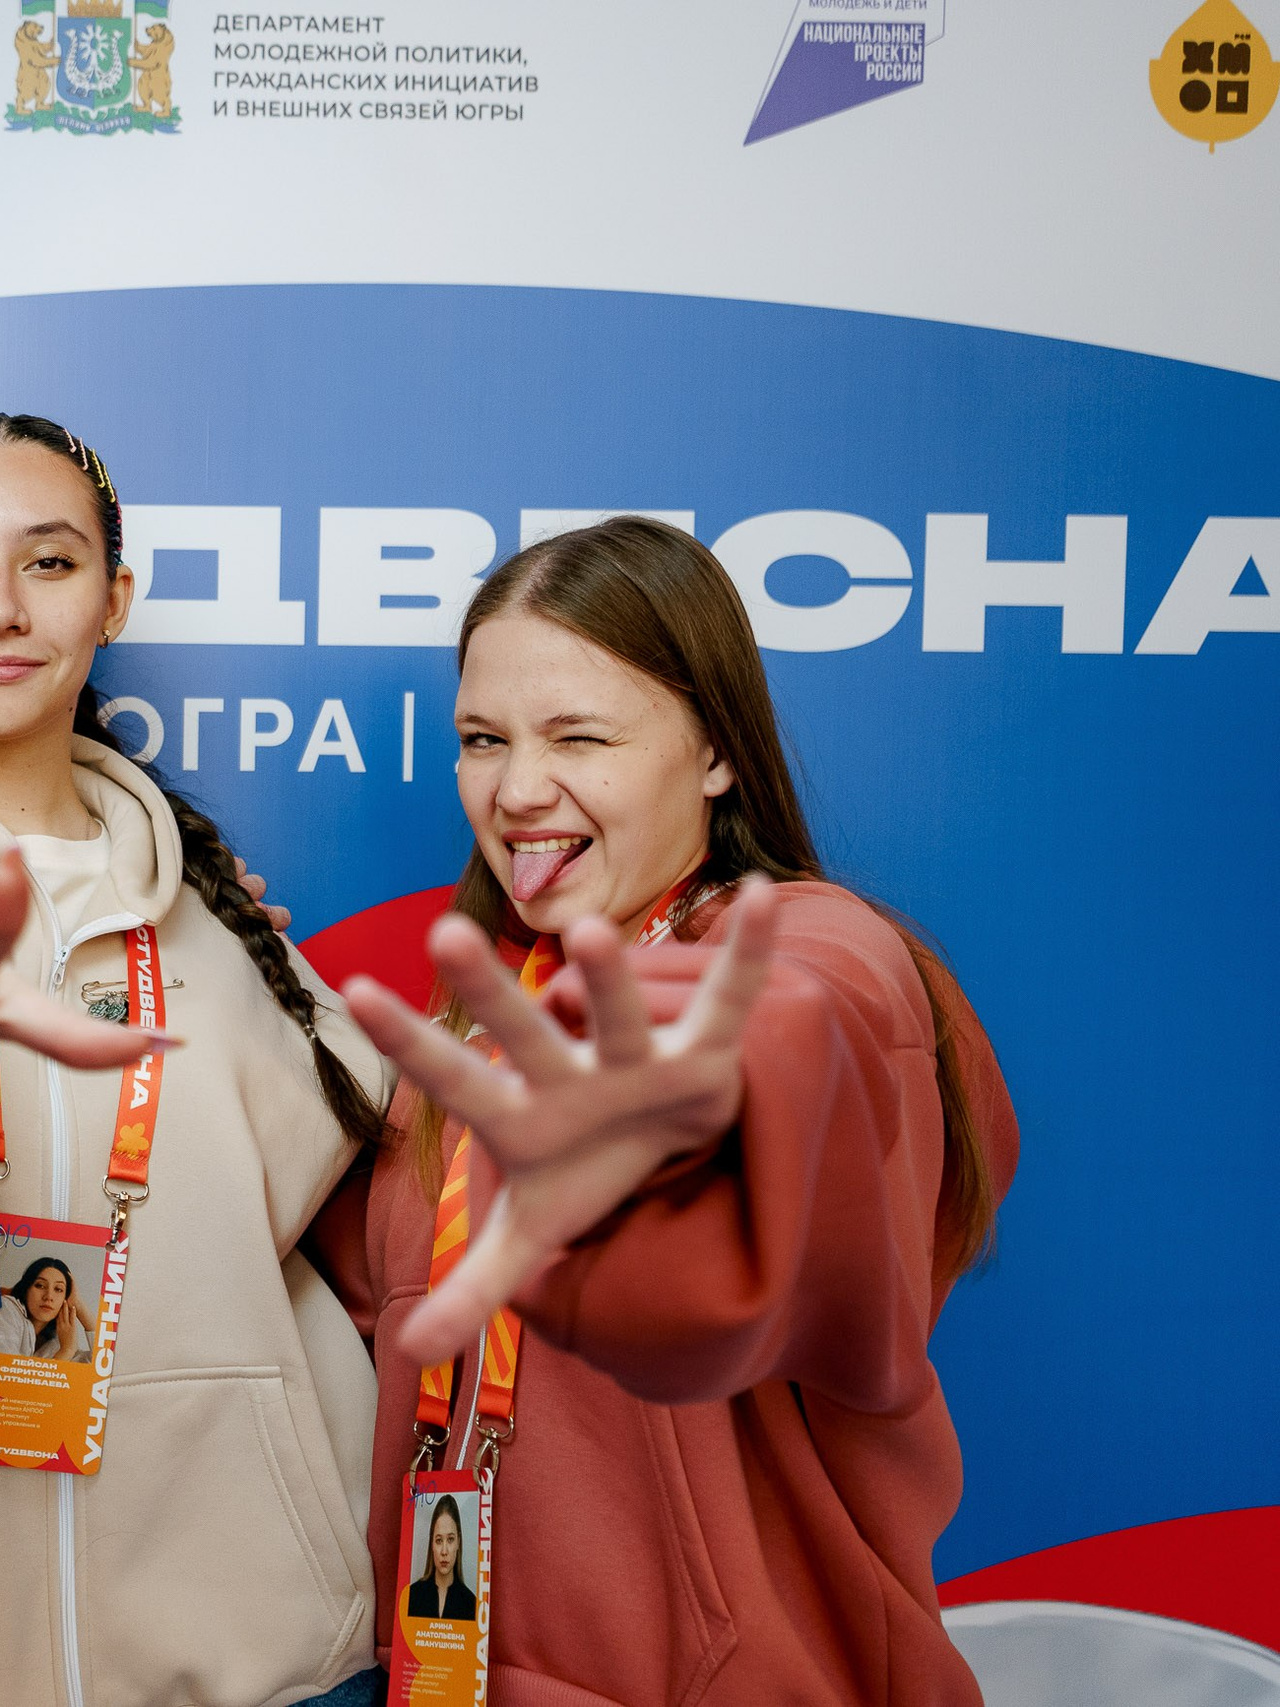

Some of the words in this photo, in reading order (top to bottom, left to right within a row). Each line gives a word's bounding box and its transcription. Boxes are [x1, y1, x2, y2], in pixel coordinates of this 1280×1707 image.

[214, 13, 384, 35] ДЕПАРТАМЕНТ
[804, 22, 924, 44] НАЦИОНАЛЬНЫЕ
[214, 41, 389, 64] МОЛОДЕЖНОЙ
[396, 45, 528, 67] ПОЛИТИКИ,
[854, 43, 922, 62] ПРОЕКТЫ
[214, 71, 387, 92] ГРАЖДАНСКИХ
[395, 73, 539, 95] ИНИЦИАТИВ
[865, 62, 921, 82] РОССИИ
[214, 100, 229, 118] И
[236, 101, 353, 120] ВНЕШНИХ
[360, 99, 448, 121] СВЯЗЕЙ
[455, 103, 524, 121] ЮГРЫ
[129, 926, 157, 1110] СТУДВЕНА
[82, 1237, 129, 1466] УЧАСТНИК
[12, 1358, 58, 1370] ЛЕЙСАН
[474, 1467, 493, 1707] ЧАСТНИК
[415, 1630, 466, 1641] АНАТОЛЬЕВНА
[429, 1622, 454, 1631] АРИНА
[415, 1639, 465, 1651] ИВАНУШКИНА
